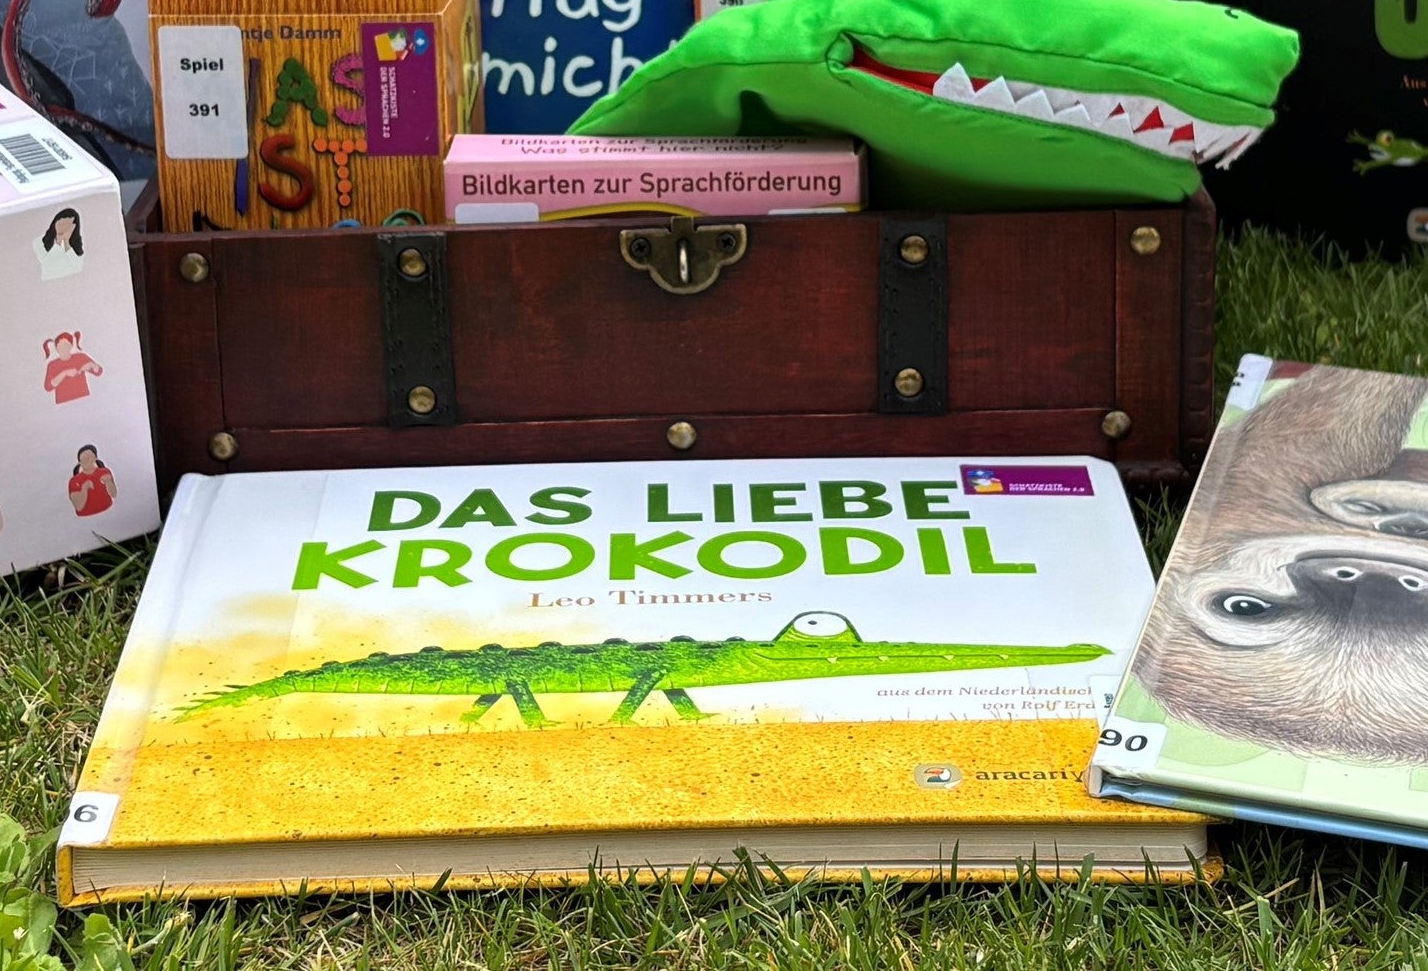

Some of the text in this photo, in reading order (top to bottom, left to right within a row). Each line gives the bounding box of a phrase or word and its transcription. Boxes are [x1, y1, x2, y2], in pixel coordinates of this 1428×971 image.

[241, 25, 342, 43] ntje Damm
[180, 58, 224, 72] Spiel
[481, 37, 678, 97] mich
[189, 104, 220, 117] 391
[463, 171, 841, 196] Bildkarten zur Sprachförderung
[368, 479, 972, 533] DAS LIEBE
[292, 525, 1038, 591] KROKODIL
[527, 585, 774, 608] Leo Timmers
[877, 688, 910, 697] aus
[914, 686, 953, 697] dem
[982, 701, 1016, 711] von
[1022, 699, 1058, 713] Rolf
[1098, 729, 1149, 752] 90
[73, 804, 100, 824] 6
